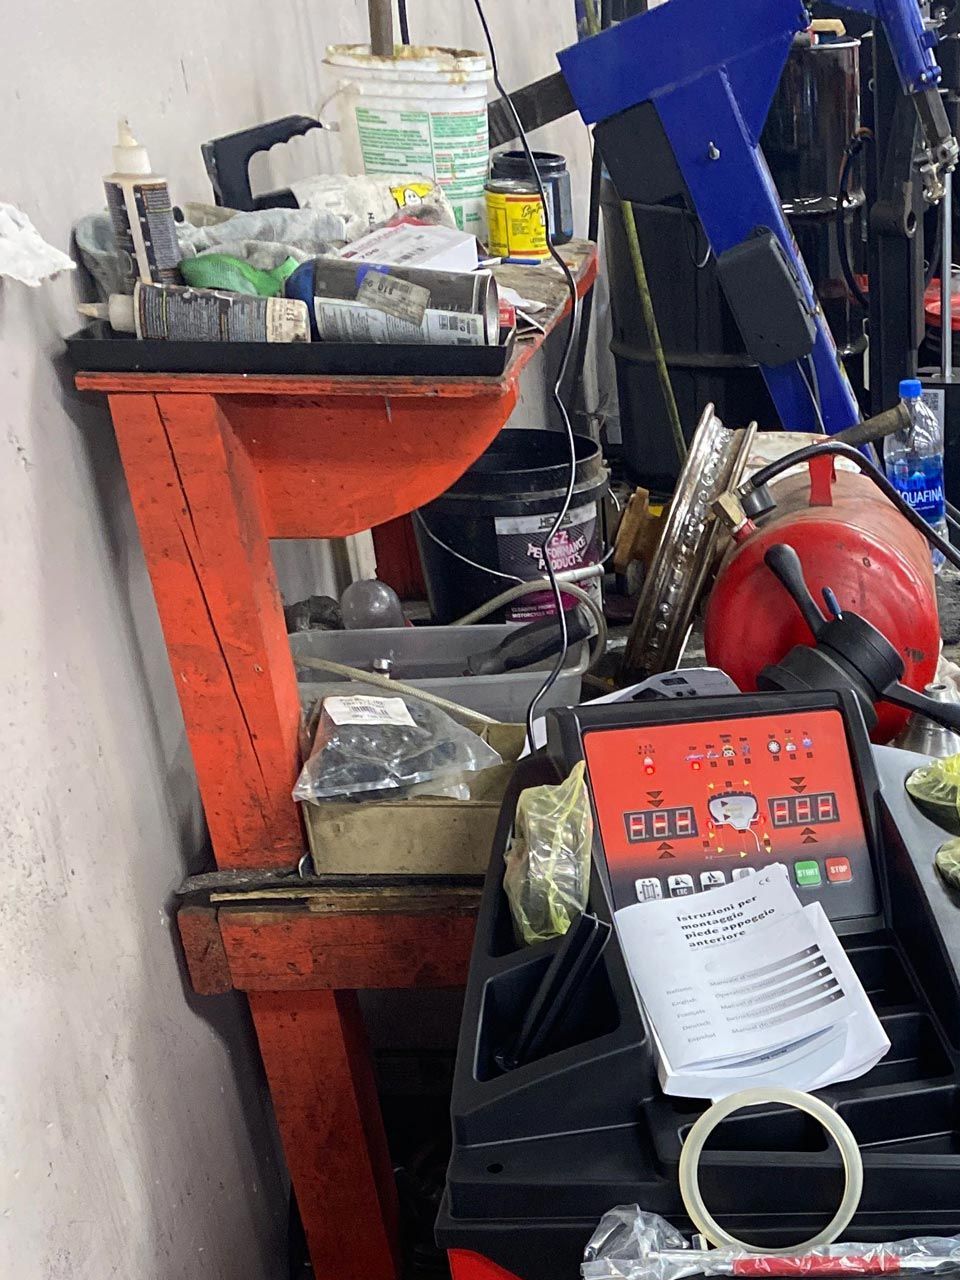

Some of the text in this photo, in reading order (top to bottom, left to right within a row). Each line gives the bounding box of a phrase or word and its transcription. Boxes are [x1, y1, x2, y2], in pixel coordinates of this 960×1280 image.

[527, 535, 586, 559] PEFORMANCE
[538, 553, 582, 570] PODUCTS
[830, 865, 848, 874] STOP
[676, 895, 758, 922] Istruzioni per
[681, 912, 744, 931] montaggio
[685, 908, 775, 940] piede appoggio
[688, 930, 746, 948] anteriore
